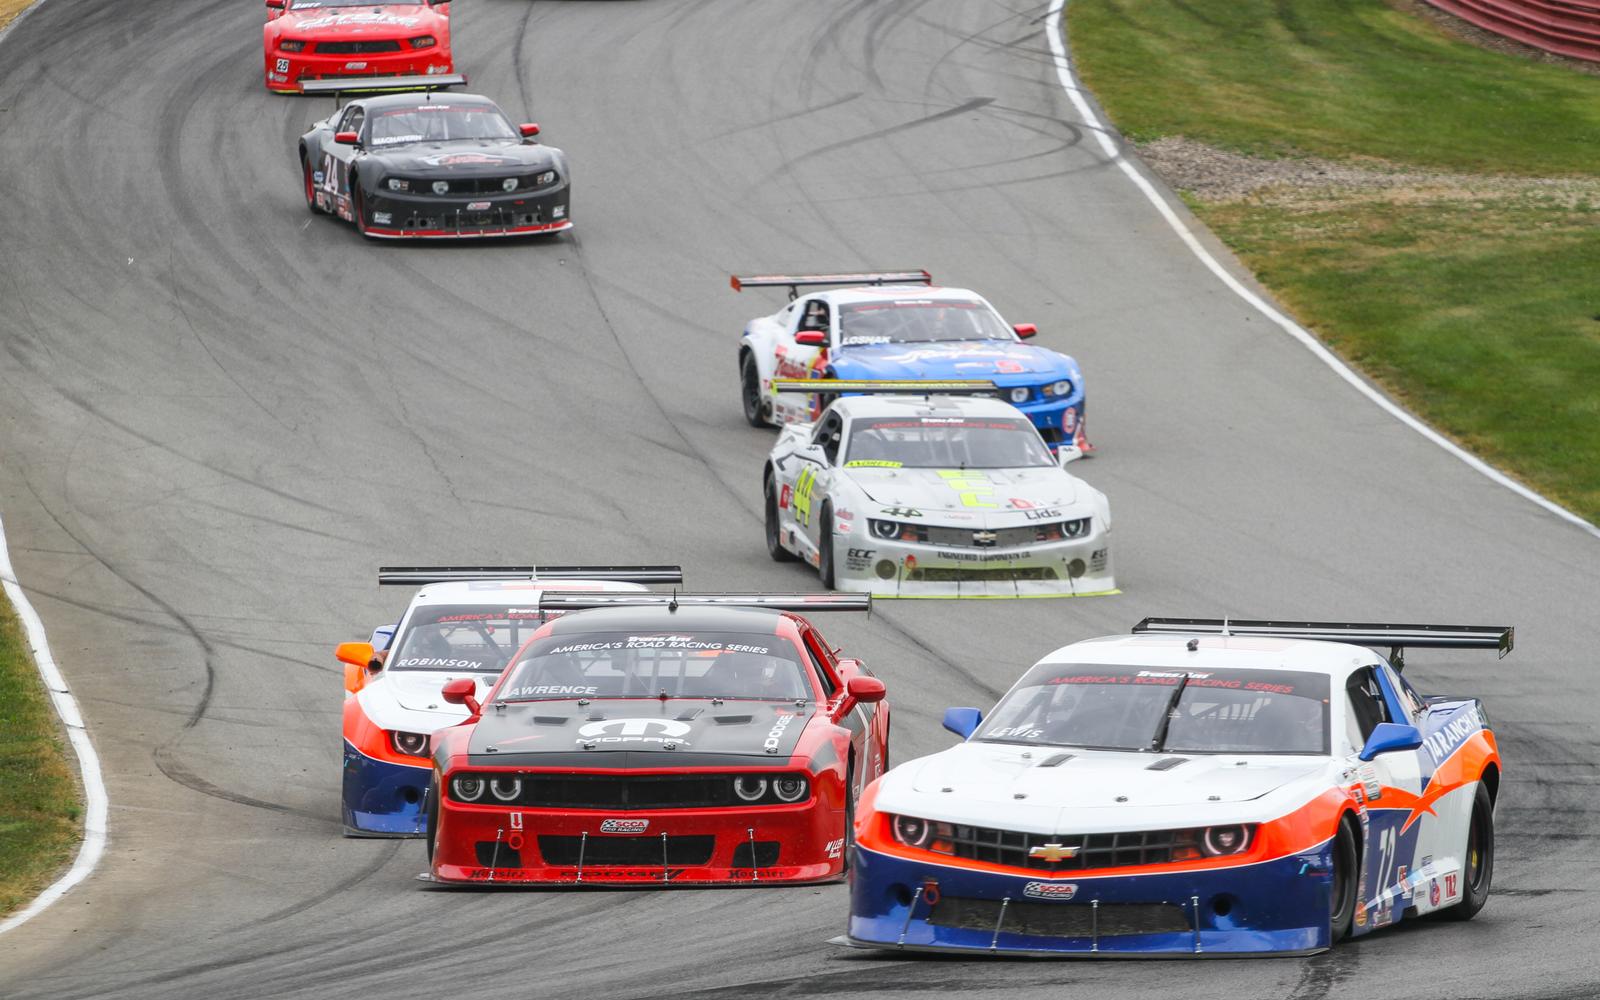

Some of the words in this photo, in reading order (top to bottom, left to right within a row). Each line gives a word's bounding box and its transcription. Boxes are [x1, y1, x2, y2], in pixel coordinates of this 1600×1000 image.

[277, 60, 288, 71] 25
[324, 154, 339, 195] 24
[842, 336, 892, 346] LOSHAK
[1024, 509, 1063, 520] Lids
[847, 547, 877, 559] ECC
[549, 641, 623, 655] AMERICA'S
[625, 641, 665, 649] ROAD
[668, 641, 723, 651] RACING
[725, 643, 769, 654] SERIES
[396, 657, 482, 670] ROBINSON
[1244, 682, 1296, 694] SERIES
[764, 714, 794, 750] DODGE
[987, 726, 1045, 738] LEWIS
